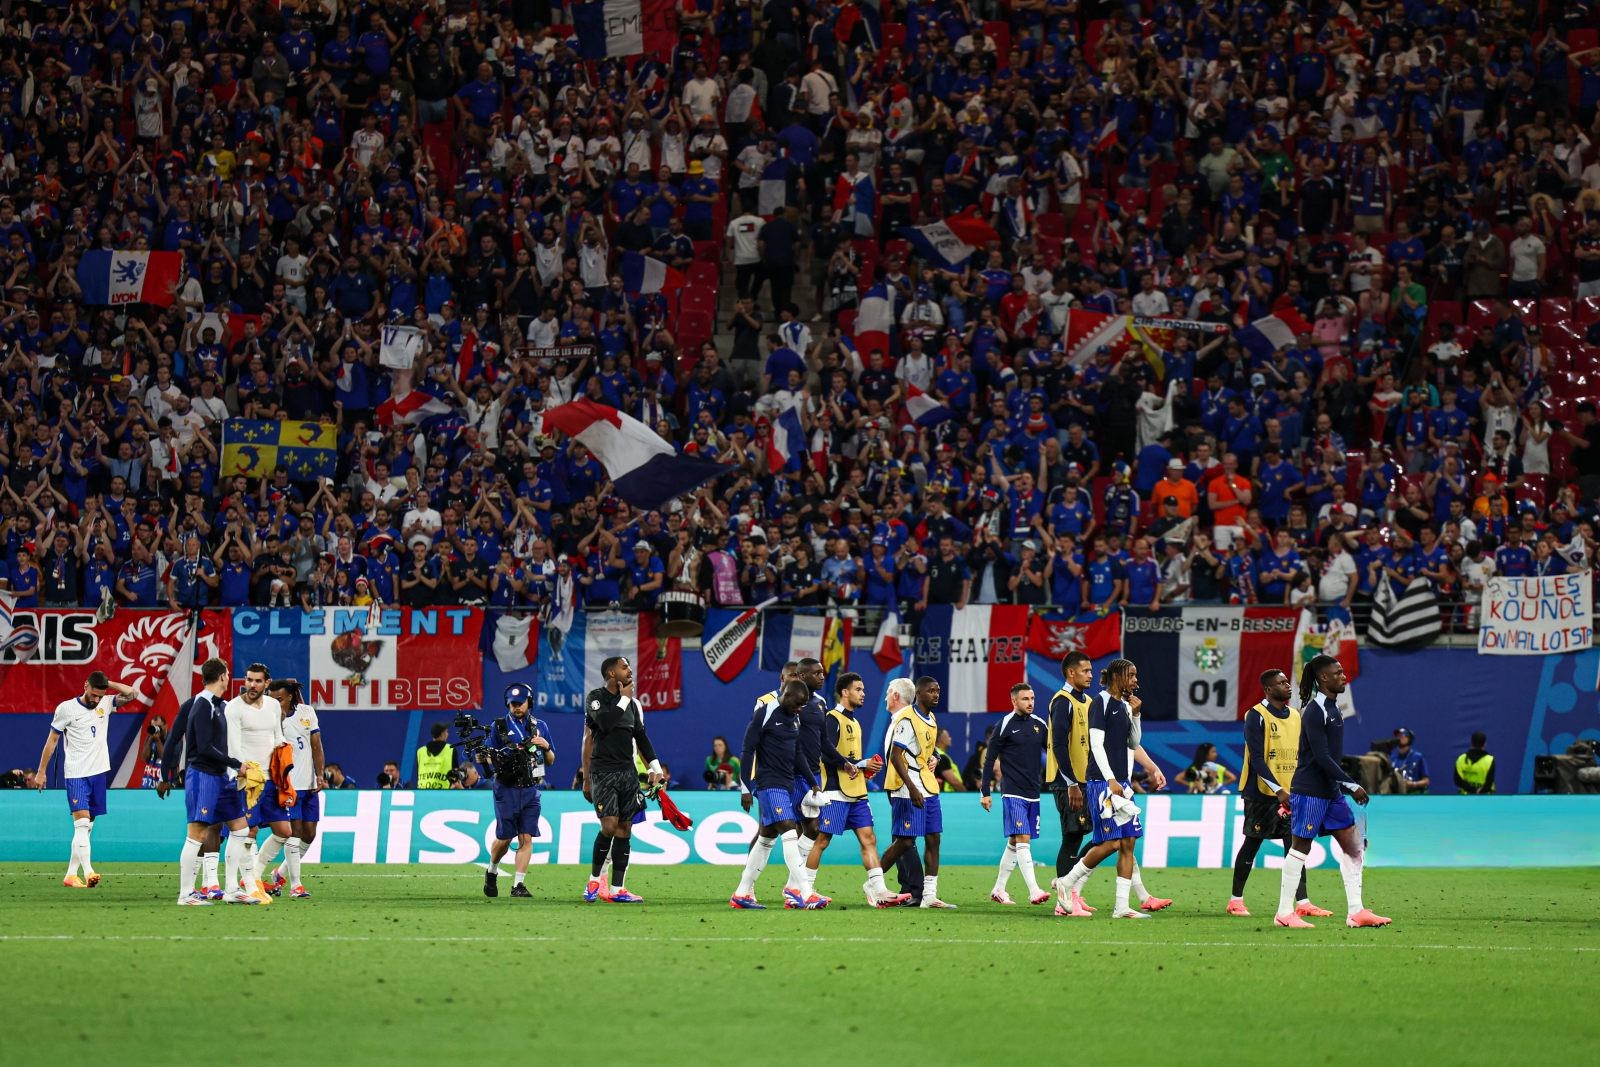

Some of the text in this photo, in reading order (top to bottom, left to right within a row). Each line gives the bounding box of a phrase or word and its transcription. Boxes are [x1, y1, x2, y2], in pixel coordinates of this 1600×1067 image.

[111, 291, 138, 304] LYON
[383, 326, 398, 346] 17
[1507, 575, 1580, 599] JULES
[232, 609, 471, 635] CLEMENT
[1125, 616, 1296, 634] BOURG-EN-BRESSE
[915, 635, 1024, 664] LE HAVRE
[1189, 678, 1228, 708] 01
[90, 725, 97, 738] 9
[296, 736, 304, 750] 5
[418, 772, 449, 782] TEWARD
